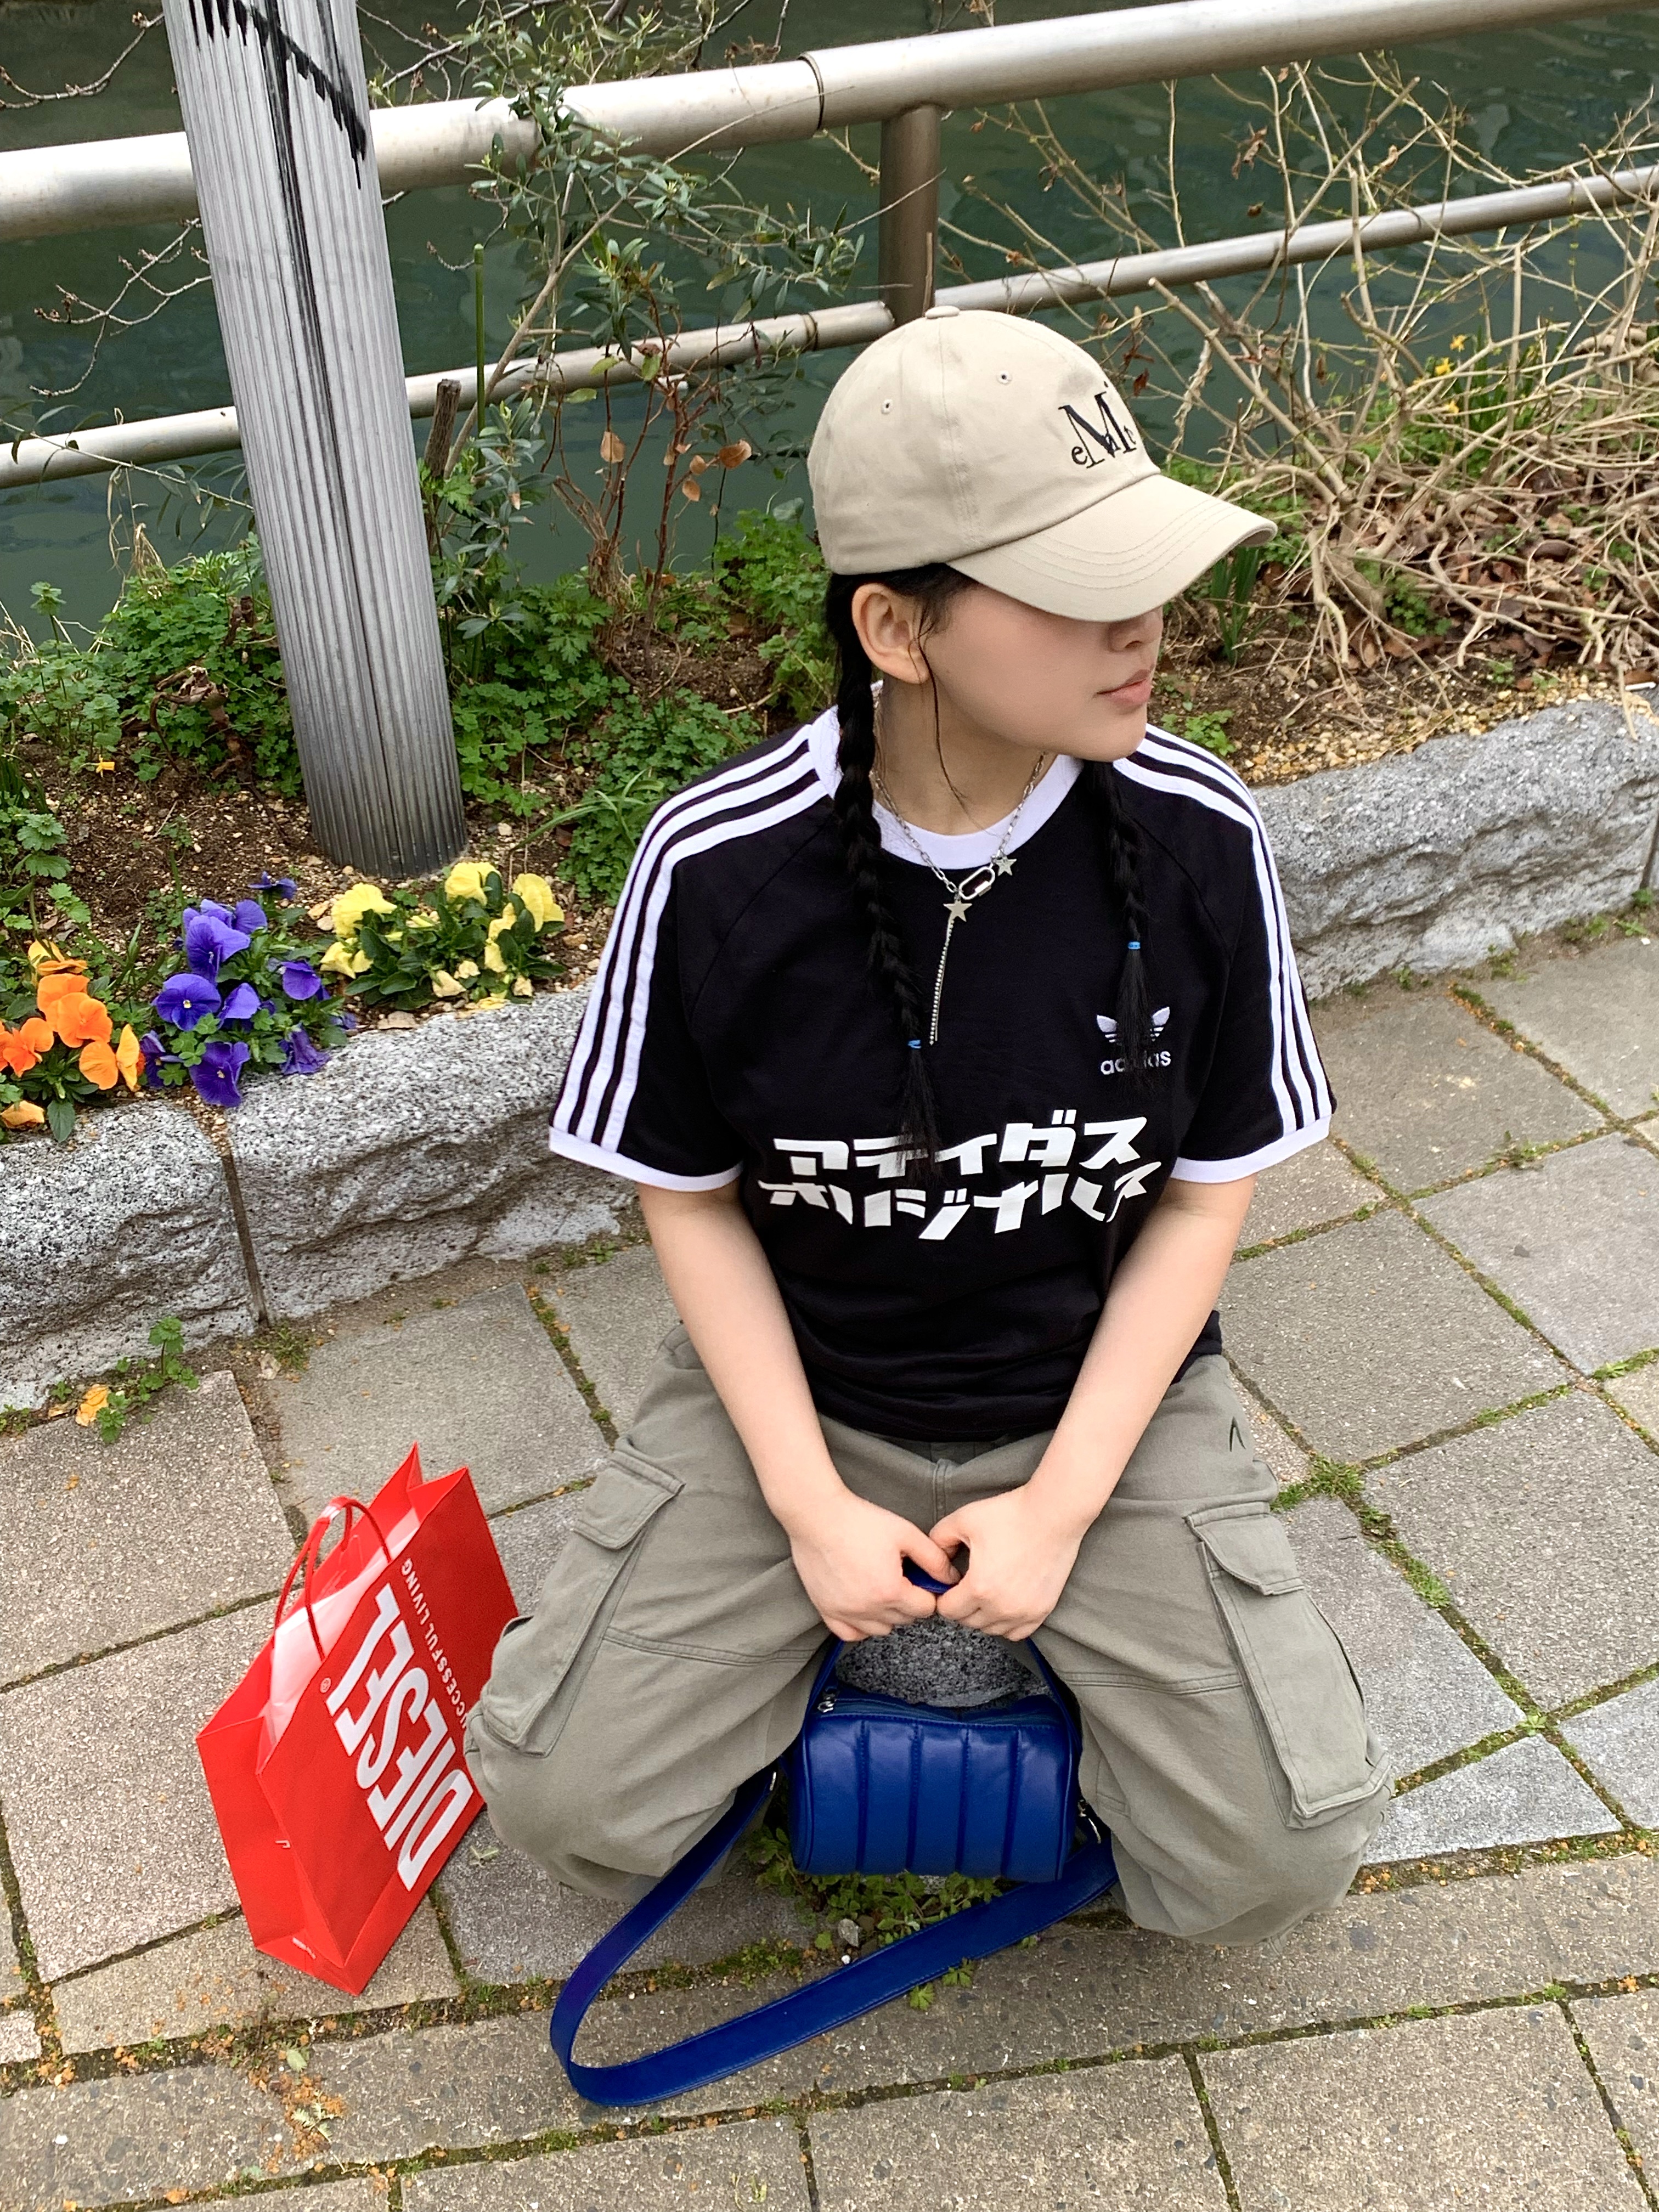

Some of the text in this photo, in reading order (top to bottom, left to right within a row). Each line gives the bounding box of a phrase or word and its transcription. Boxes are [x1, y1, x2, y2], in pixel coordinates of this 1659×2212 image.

[1100, 1050, 1172, 1075] adas
[401, 1558, 468, 1729] UCCESSFUL LIVING
[326, 1583, 474, 1892] DIESEL
